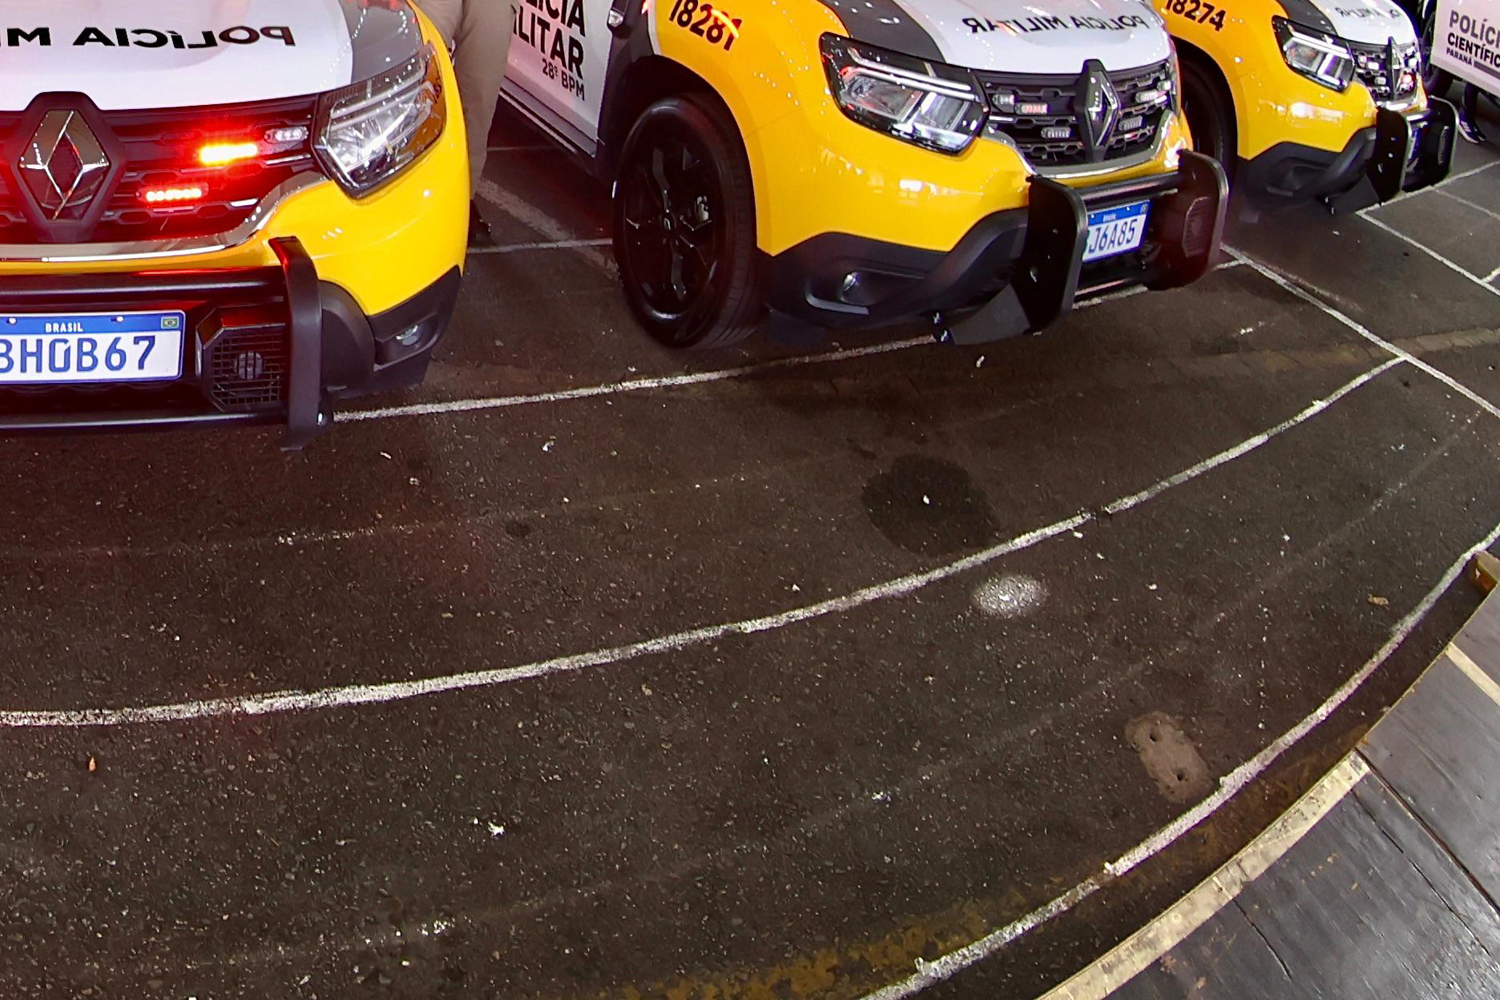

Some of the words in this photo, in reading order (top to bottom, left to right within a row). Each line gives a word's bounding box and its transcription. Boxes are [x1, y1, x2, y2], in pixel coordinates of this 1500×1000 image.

[1447, 32, 1500, 68] CIENTÍFIC
[561, 70, 585, 101] BPM
[45, 322, 83, 333] BRASIL
